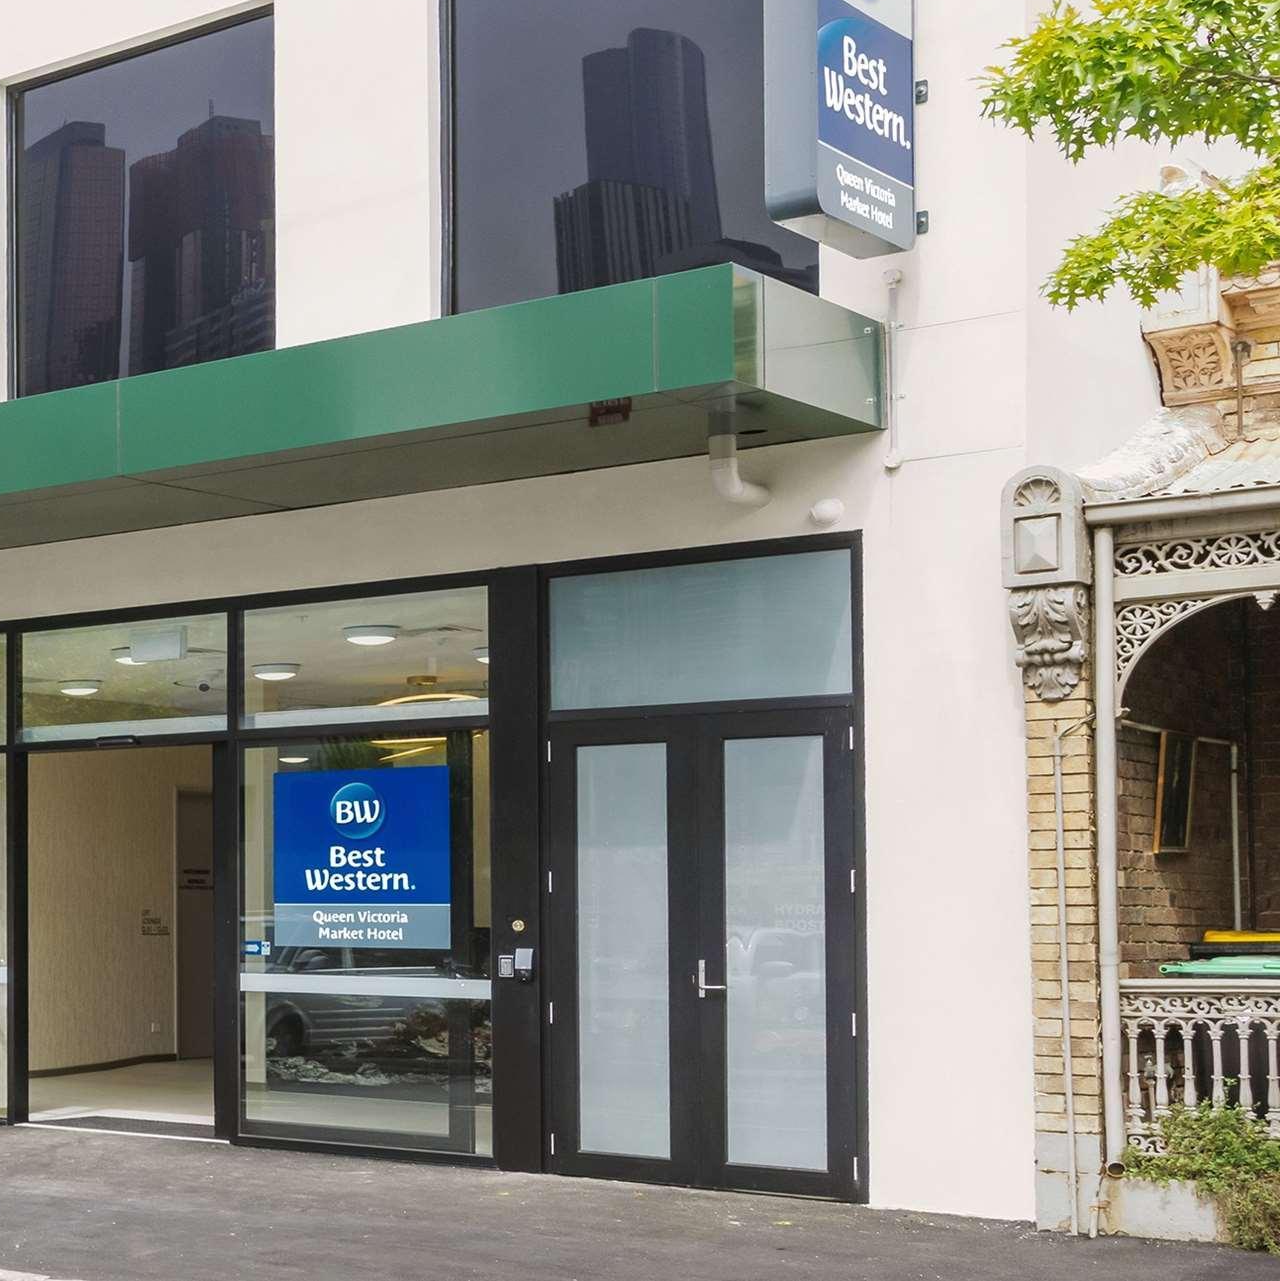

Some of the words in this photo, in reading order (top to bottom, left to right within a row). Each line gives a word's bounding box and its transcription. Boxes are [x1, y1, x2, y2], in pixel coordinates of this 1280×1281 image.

[843, 34, 888, 96] Best
[836, 163, 864, 192] Queen
[864, 176, 896, 208] Victoria
[840, 190, 870, 219] Market
[870, 204, 894, 229] Hotel
[335, 799, 380, 824] BW
[329, 846, 386, 868] Best
[312, 910, 355, 925] Queen
[356, 910, 409, 924] Victoria
[318, 926, 364, 940] Market
[366, 927, 403, 940] Hotel
